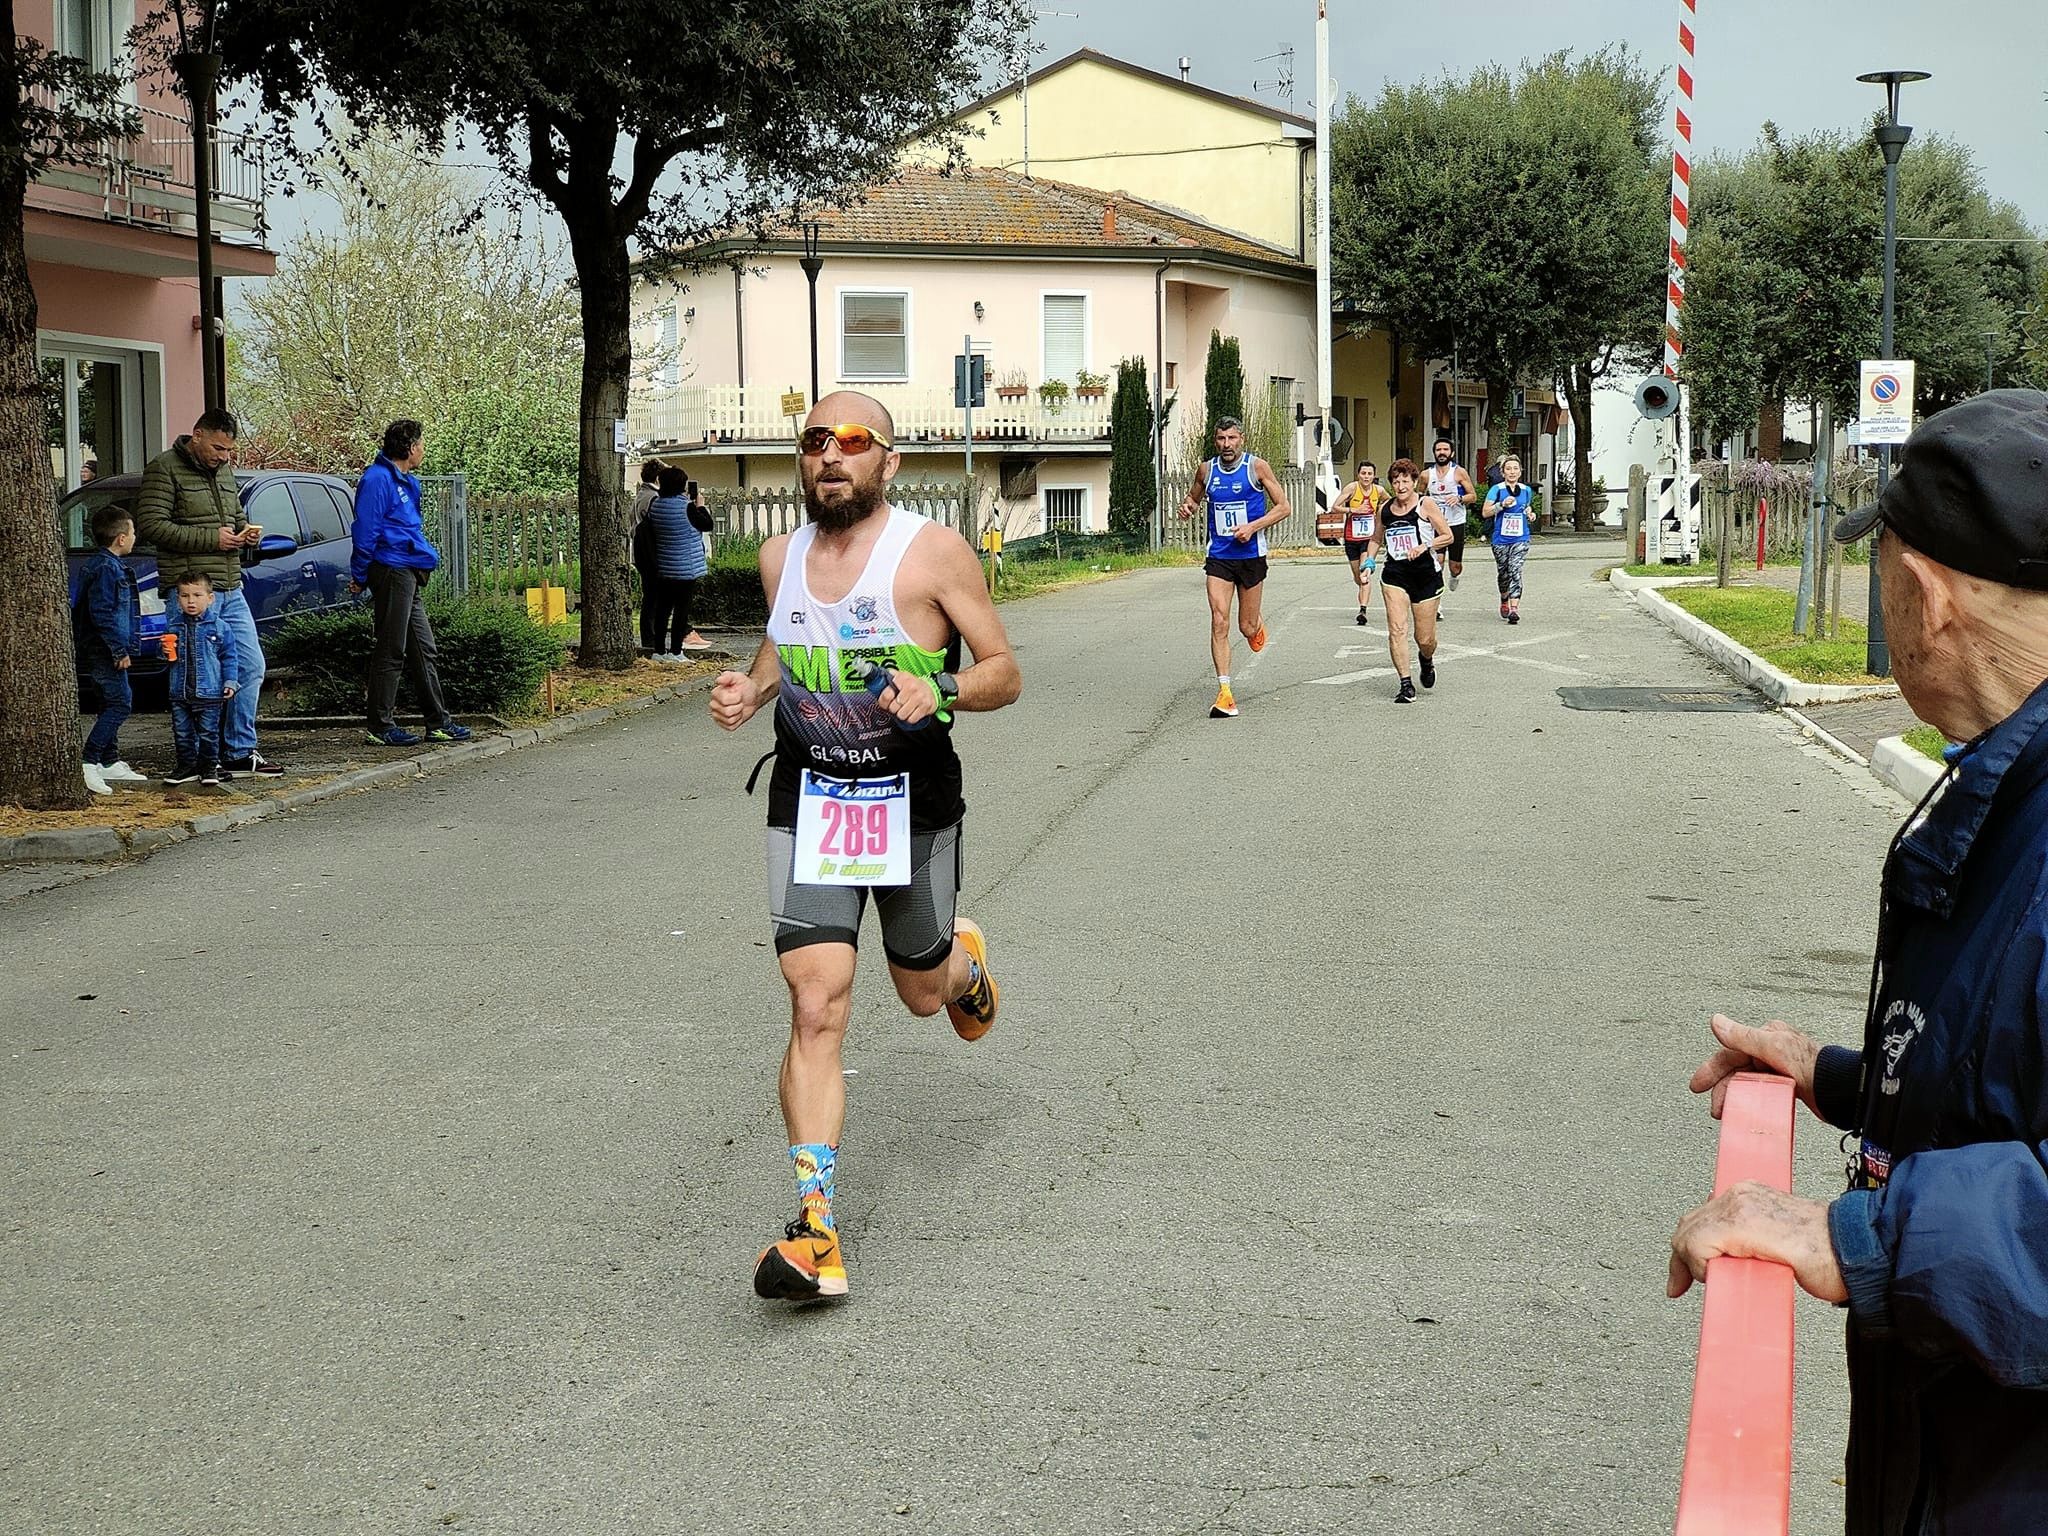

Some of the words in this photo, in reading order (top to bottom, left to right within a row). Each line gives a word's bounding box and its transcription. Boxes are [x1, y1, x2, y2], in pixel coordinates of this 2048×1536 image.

[1452, 384, 1486, 396] TBACCHERIA
[1225, 511, 1238, 527] 81
[1360, 521, 1369, 532] 76
[1505, 519, 1520, 530] 244
[1392, 535, 1413, 552] 249
[842, 645, 896, 660] POSSIBLE
[810, 744, 888, 764] GLOBAL
[819, 801, 888, 857] 289
